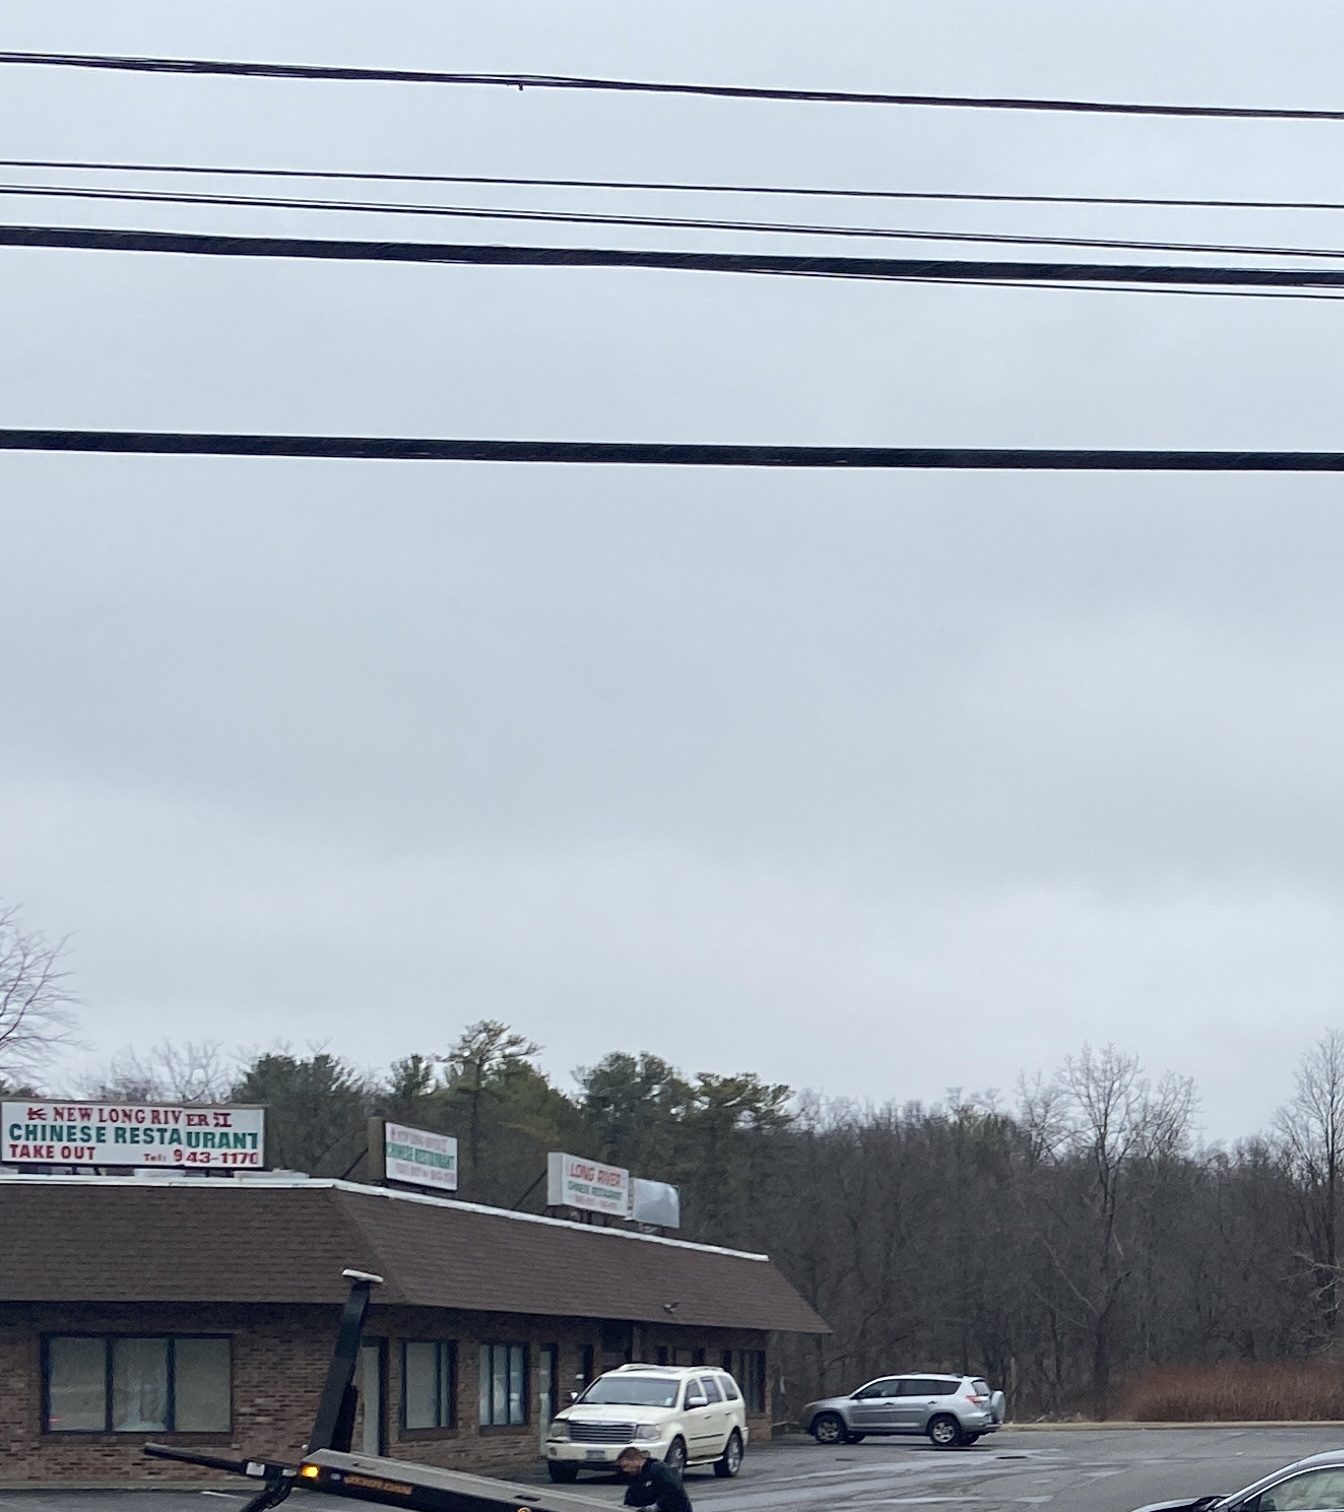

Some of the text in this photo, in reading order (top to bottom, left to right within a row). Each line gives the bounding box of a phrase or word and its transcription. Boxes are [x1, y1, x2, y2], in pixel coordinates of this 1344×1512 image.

[53, 1107, 210, 1127] NEW LONG RIVER
[8, 1124, 258, 1149] CHINESE RESTAURANT
[9, 1144, 96, 1160] TAKE OUT
[570, 1163, 595, 1181] LONG
